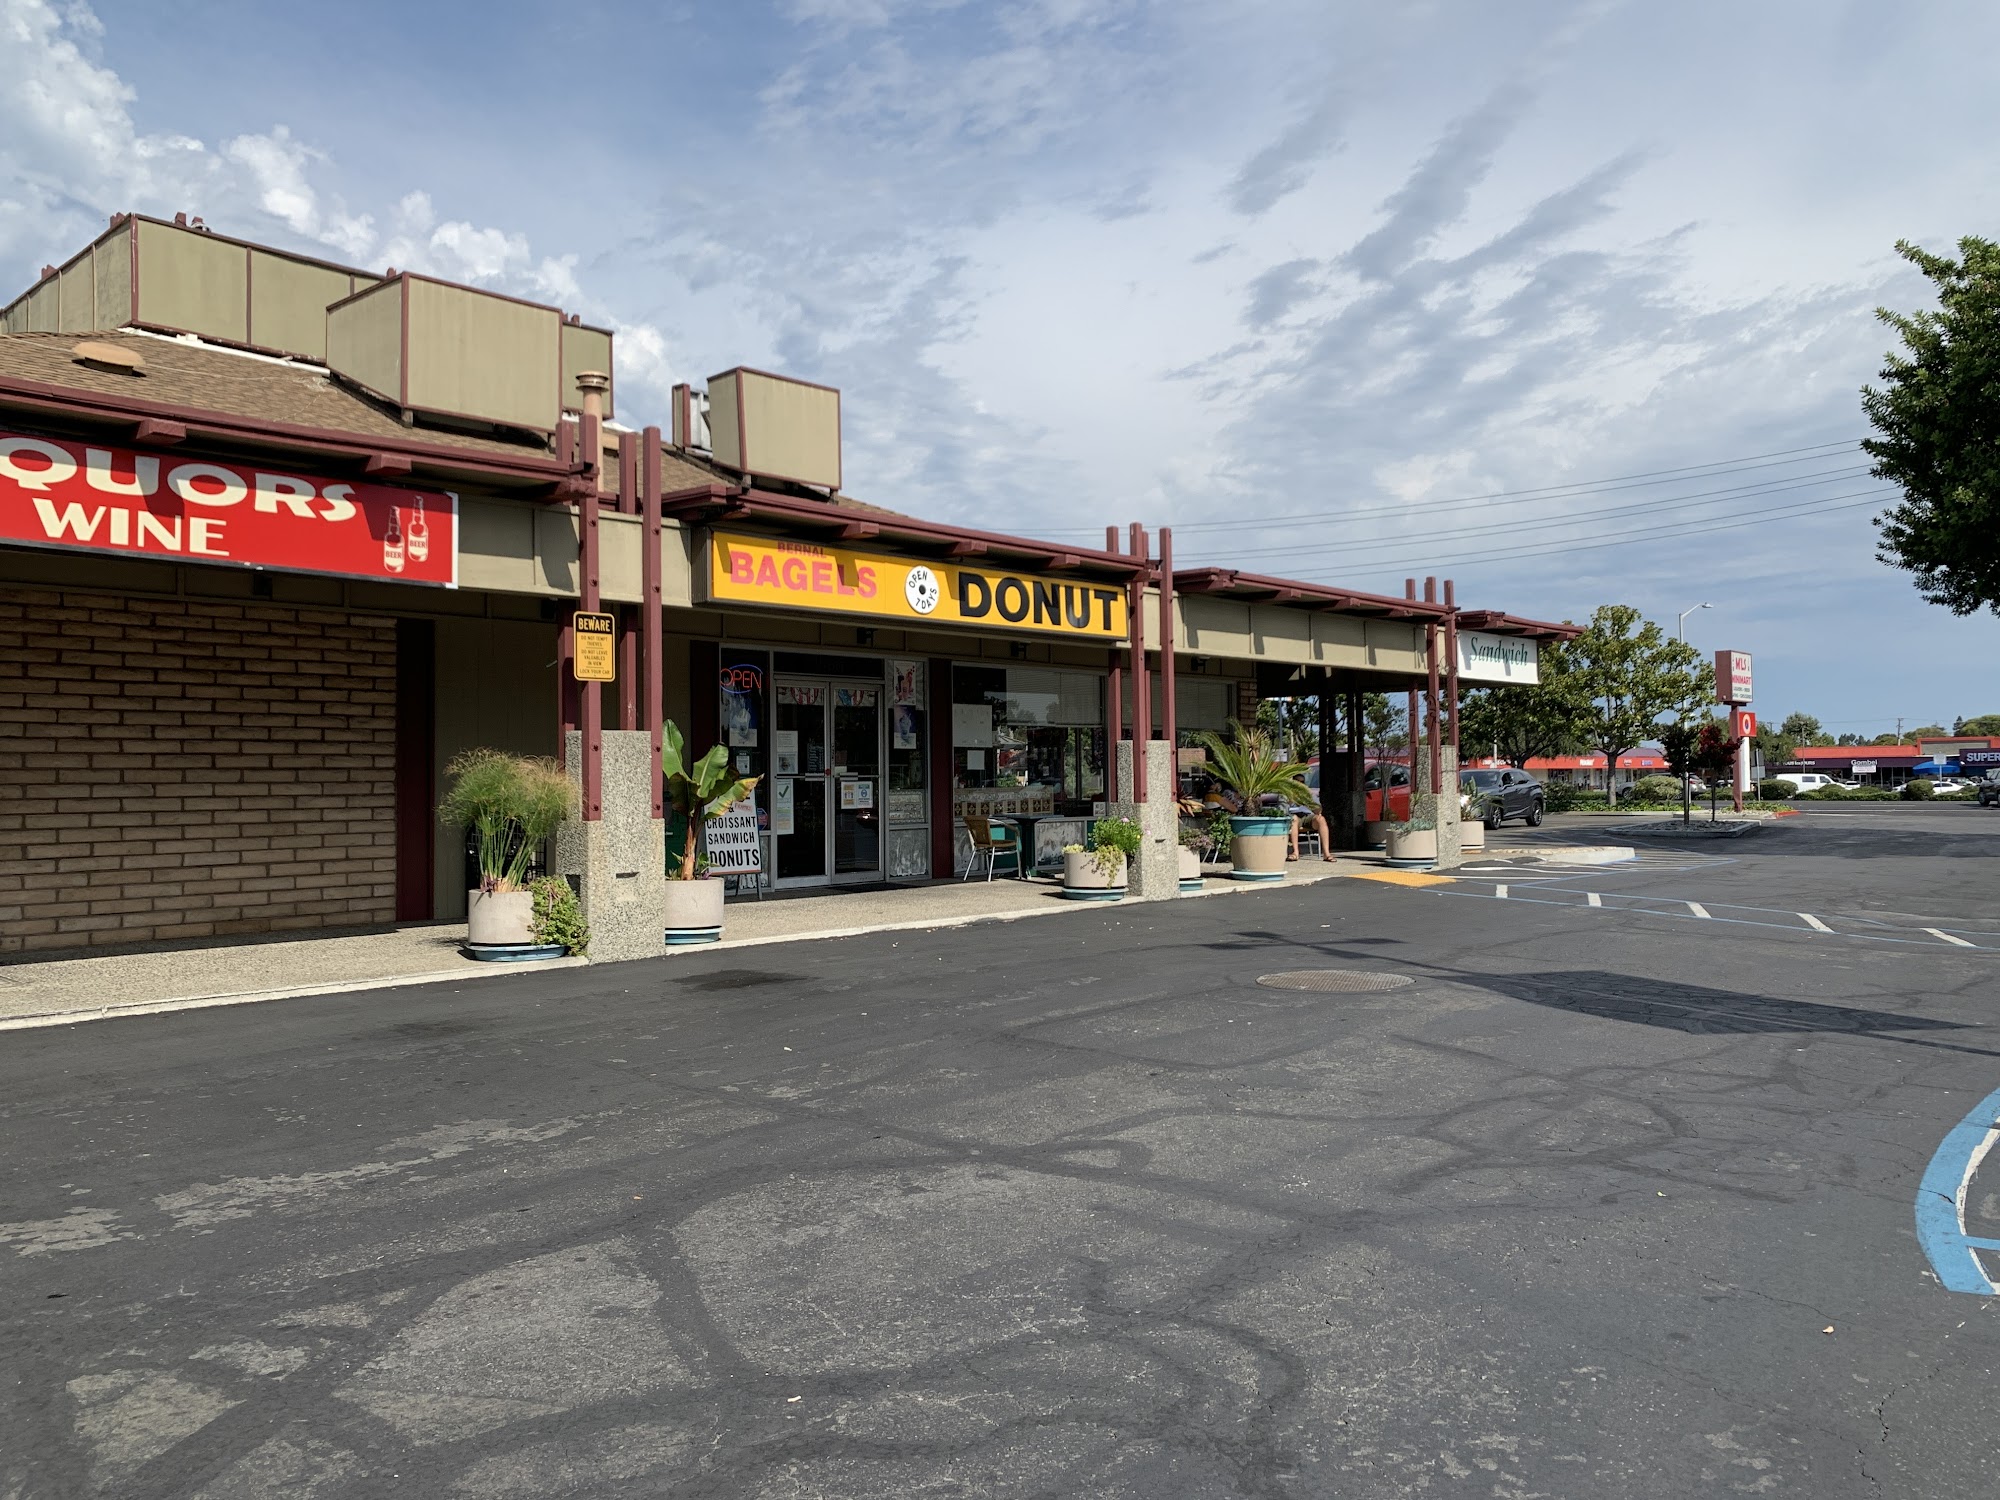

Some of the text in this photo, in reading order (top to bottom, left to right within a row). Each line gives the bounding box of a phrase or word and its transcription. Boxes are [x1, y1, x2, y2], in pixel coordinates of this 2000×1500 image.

[32, 497, 230, 557] WINE
[410, 540, 426, 548] BEER
[777, 542, 827, 559] BERNAL
[386, 550, 402, 559] BEER
[729, 551, 878, 598] BAGELS
[908, 570, 928, 589] OPEN
[957, 570, 1119, 632] DONUT
[578, 617, 611, 632] BEWARE
[1469, 635, 1529, 668] Sandwich
[720, 668, 762, 689] OPEN
[706, 815, 756, 829] CROISSANT
[708, 831, 755, 845] SANDWICH
[709, 848, 760, 868] DONUTS
